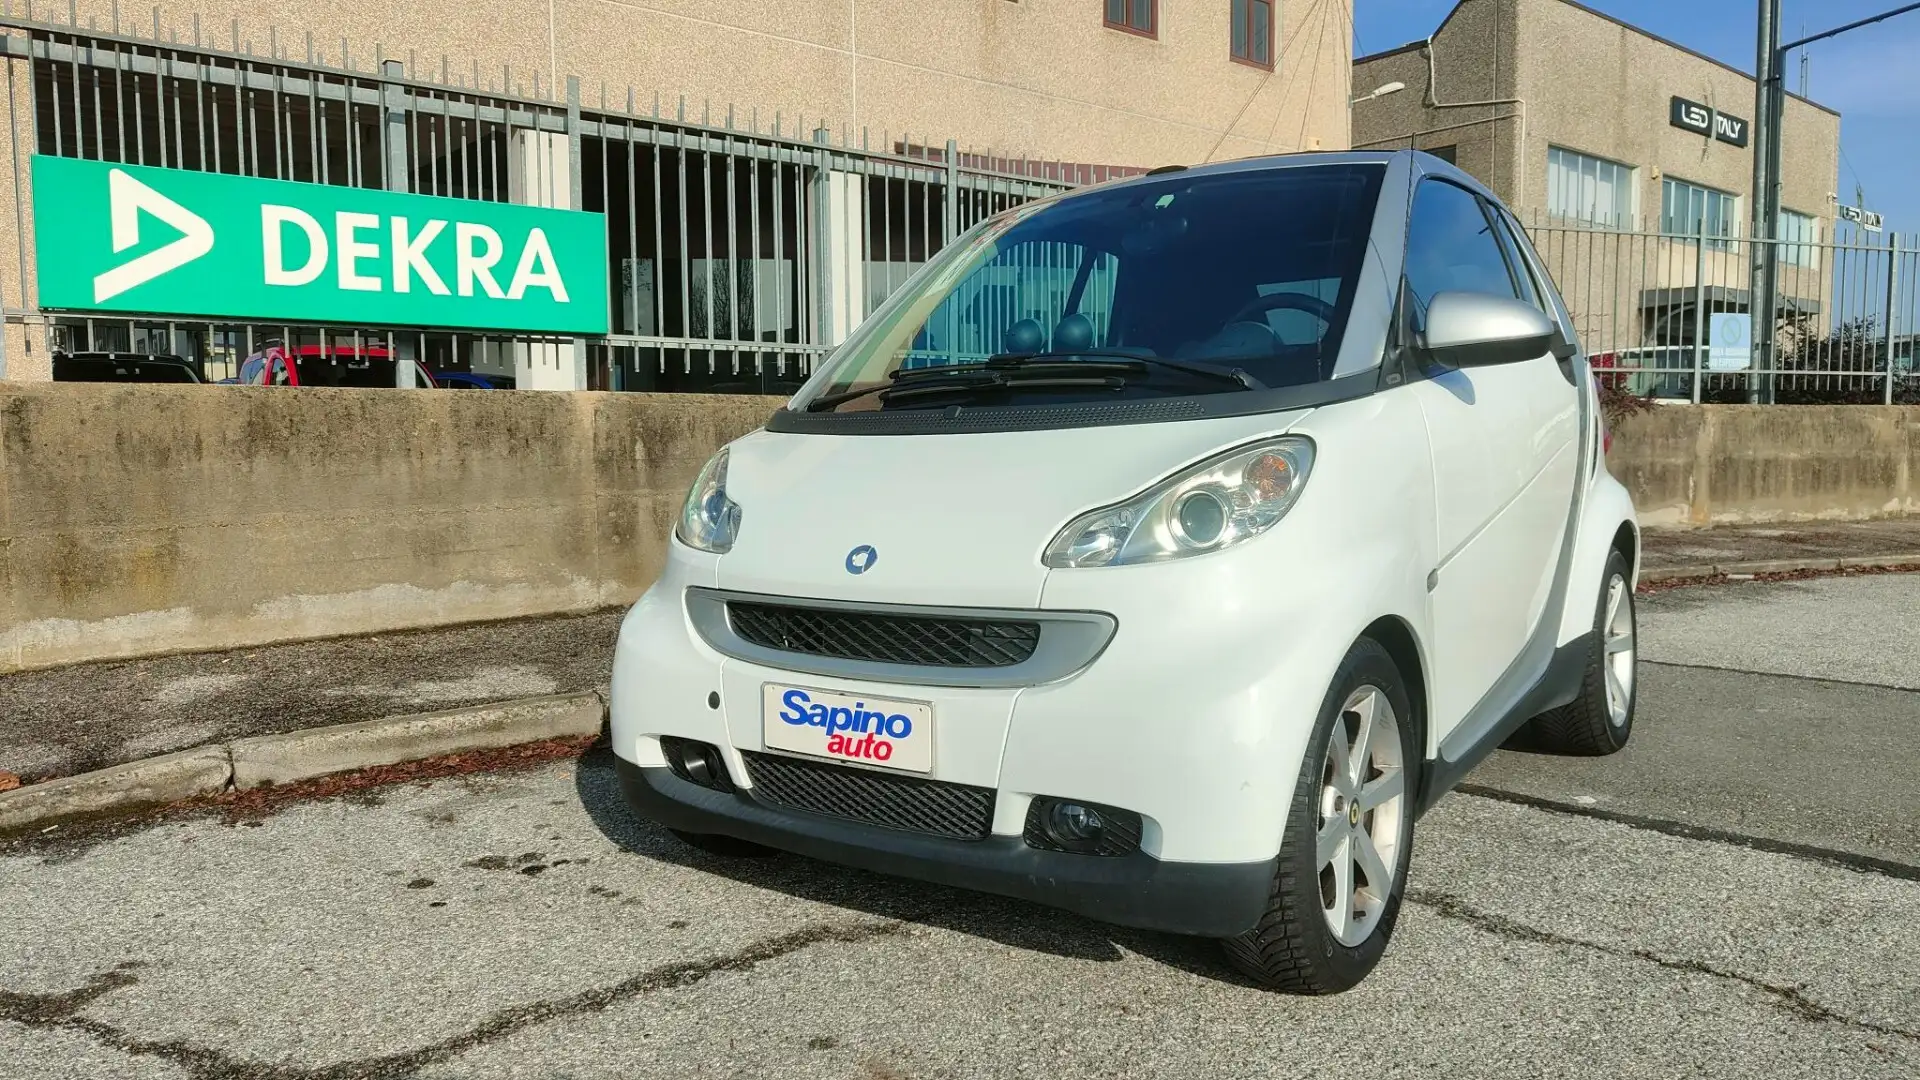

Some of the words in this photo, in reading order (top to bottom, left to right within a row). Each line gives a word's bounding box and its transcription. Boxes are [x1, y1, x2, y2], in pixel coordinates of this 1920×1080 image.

[1681, 103, 1708, 128] LED
[1714, 115, 1741, 138] TALY
[261, 203, 570, 303] DEKRA
[779, 689, 912, 738] Sapino
[827, 732, 893, 761] auto
